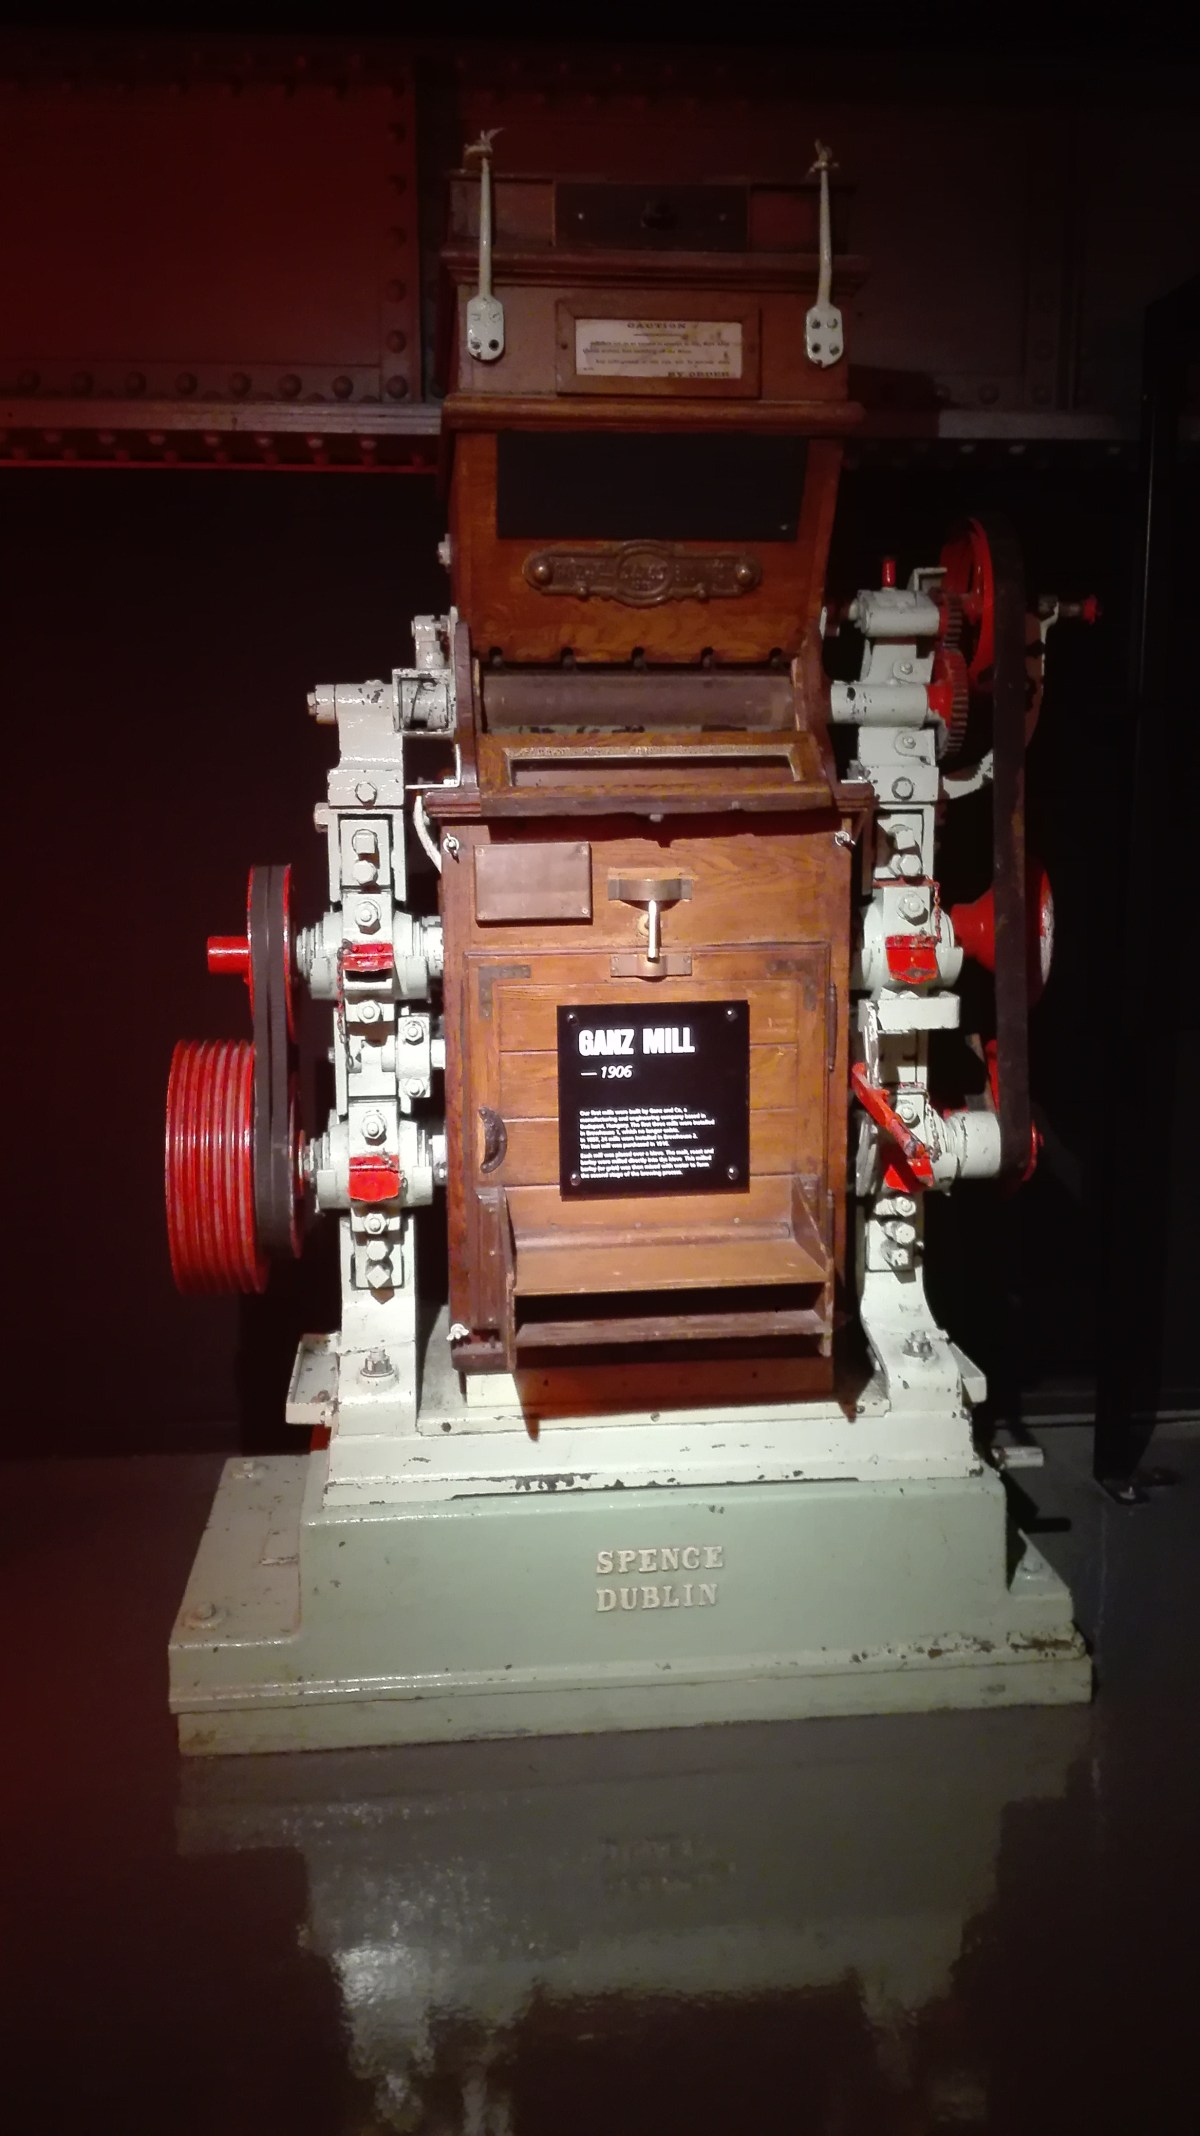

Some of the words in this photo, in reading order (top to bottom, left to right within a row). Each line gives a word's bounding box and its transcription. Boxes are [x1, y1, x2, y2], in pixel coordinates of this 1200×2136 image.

[578, 1029, 634, 1056] GANZ
[642, 1027, 695, 1054] MILL
[601, 1065, 632, 1078] 1906
[596, 1546, 724, 1574] SPENCE
[596, 1583, 718, 1612] DUBLIN
